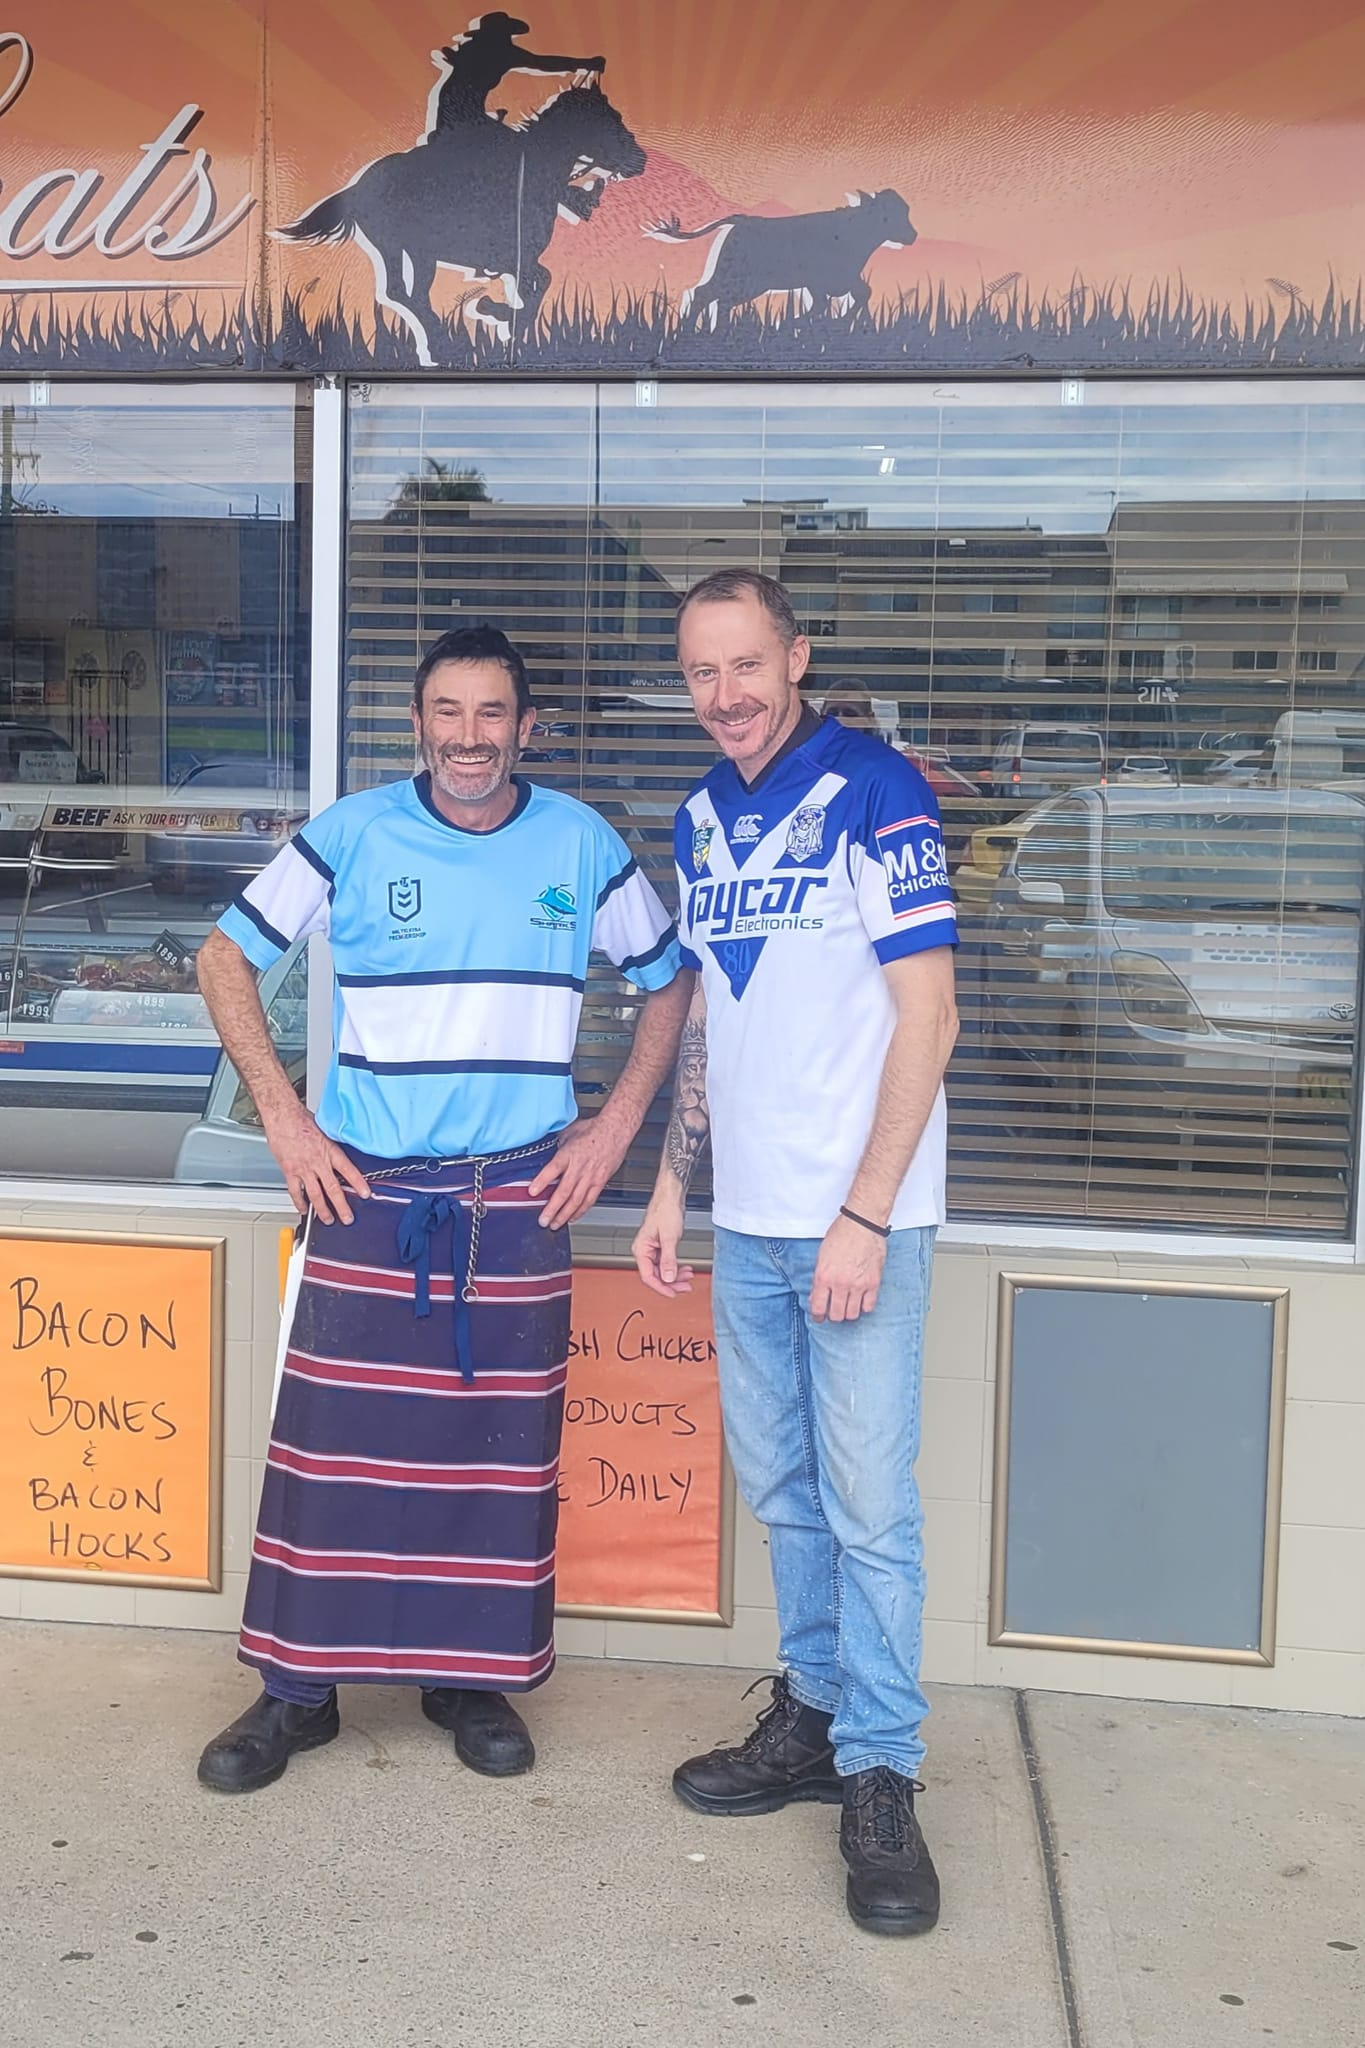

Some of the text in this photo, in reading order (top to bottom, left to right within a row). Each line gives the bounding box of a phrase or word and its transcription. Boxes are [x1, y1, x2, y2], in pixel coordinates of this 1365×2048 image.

[52, 807, 111, 827] BEEF
[113, 812, 137, 825] ASK
[139, 813, 167, 826] YOUR
[735, 915, 824, 933] Electronics
[156, 943, 178, 966] 1899
[723, 941, 751, 975] 80
[23, 1003, 50, 1017] 1999
[10, 1276, 177, 1350] BACON
[28, 1366, 177, 1440] BONES
[29, 1477, 164, 1514] BACON
[587, 1457, 692, 1514] DAILY
[50, 1521, 172, 1562] HOCKS
